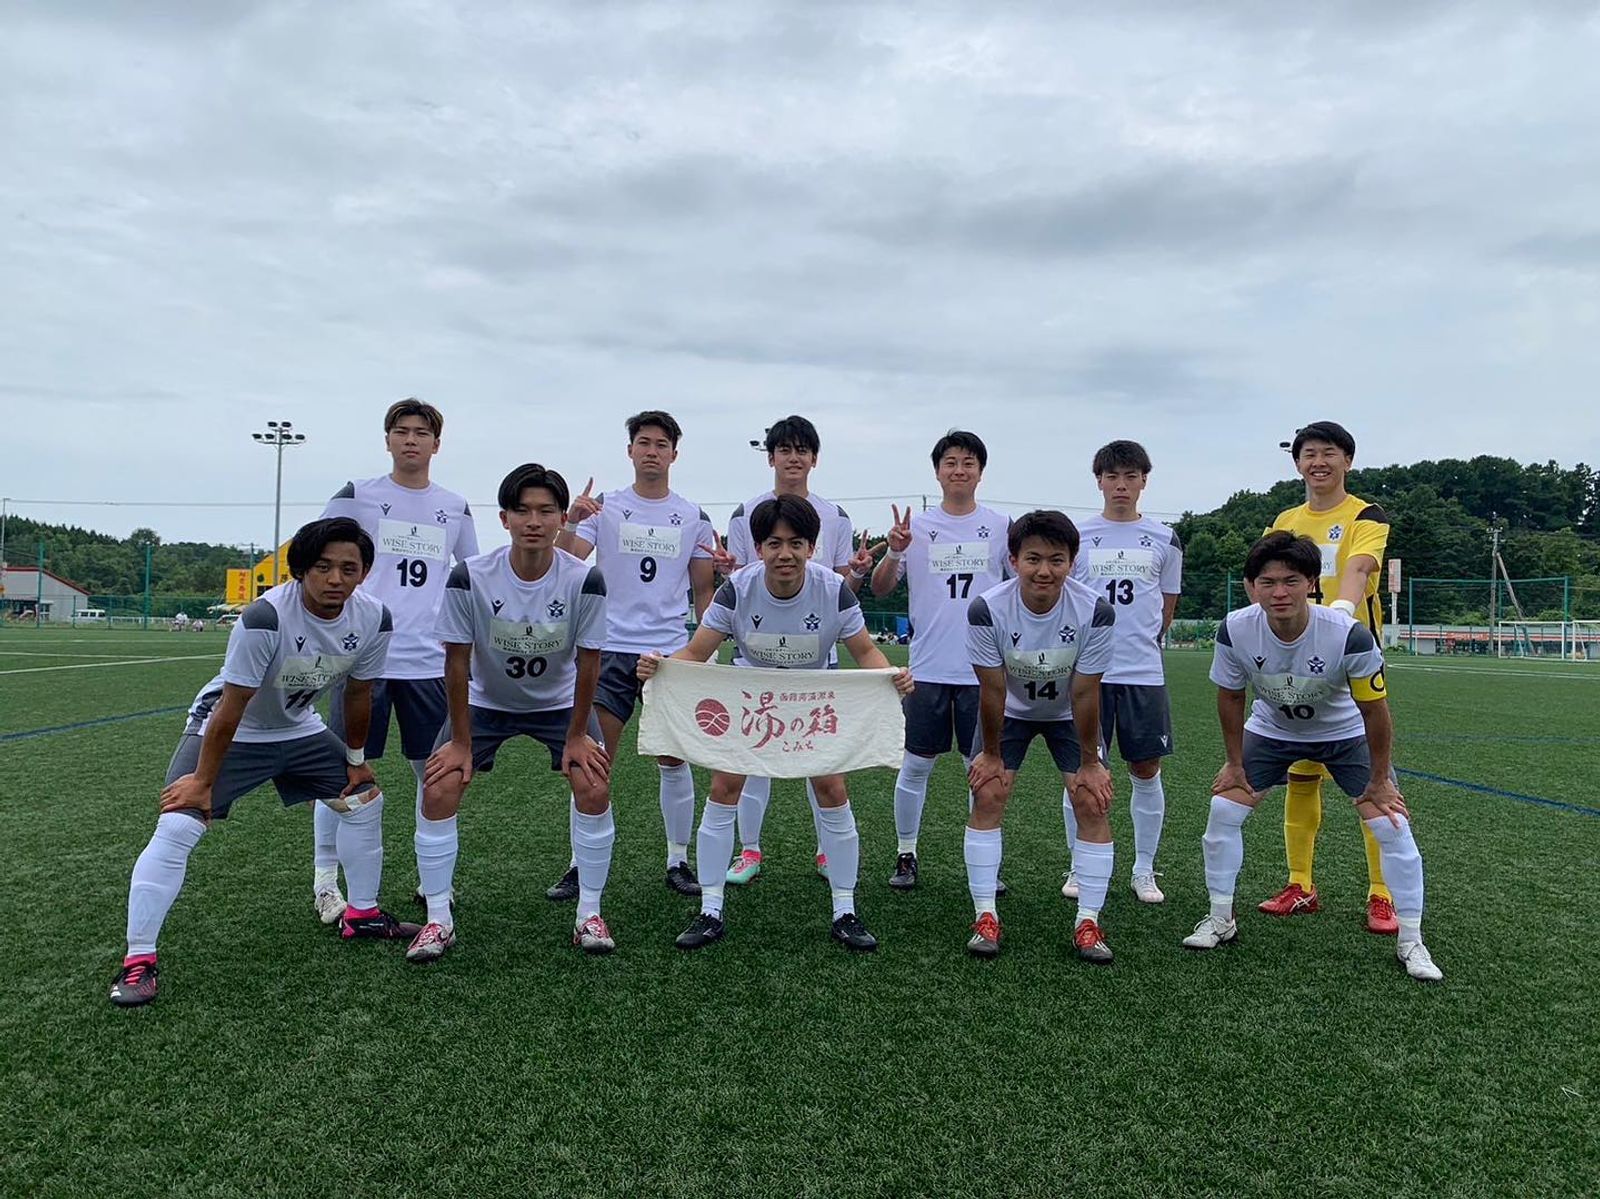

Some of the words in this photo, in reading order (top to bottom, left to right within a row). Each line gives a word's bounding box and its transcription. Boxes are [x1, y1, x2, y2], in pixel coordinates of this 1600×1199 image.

[383, 537, 407, 549] WISE
[409, 542, 442, 554] STORY
[623, 539, 646, 549] WISE
[647, 541, 677, 553] STORY
[639, 556, 657, 583] 9
[932, 559, 954, 568] WISE
[954, 558, 986, 567] STORY
[1092, 564, 1115, 573] WISE
[1117, 564, 1149, 574] STORY
[396, 558, 428, 587] 19
[946, 573, 974, 599] 17
[1105, 579, 1134, 606] 13
[494, 636, 521, 649] WISE
[524, 638, 562, 650] STORY
[750, 648, 776, 659] WISE
[779, 650, 815, 661] STORY
[505, 656, 548, 679] 30
[1023, 680, 1059, 700] 14
[284, 689, 319, 711] 11
[1278, 704, 1315, 720] 10
